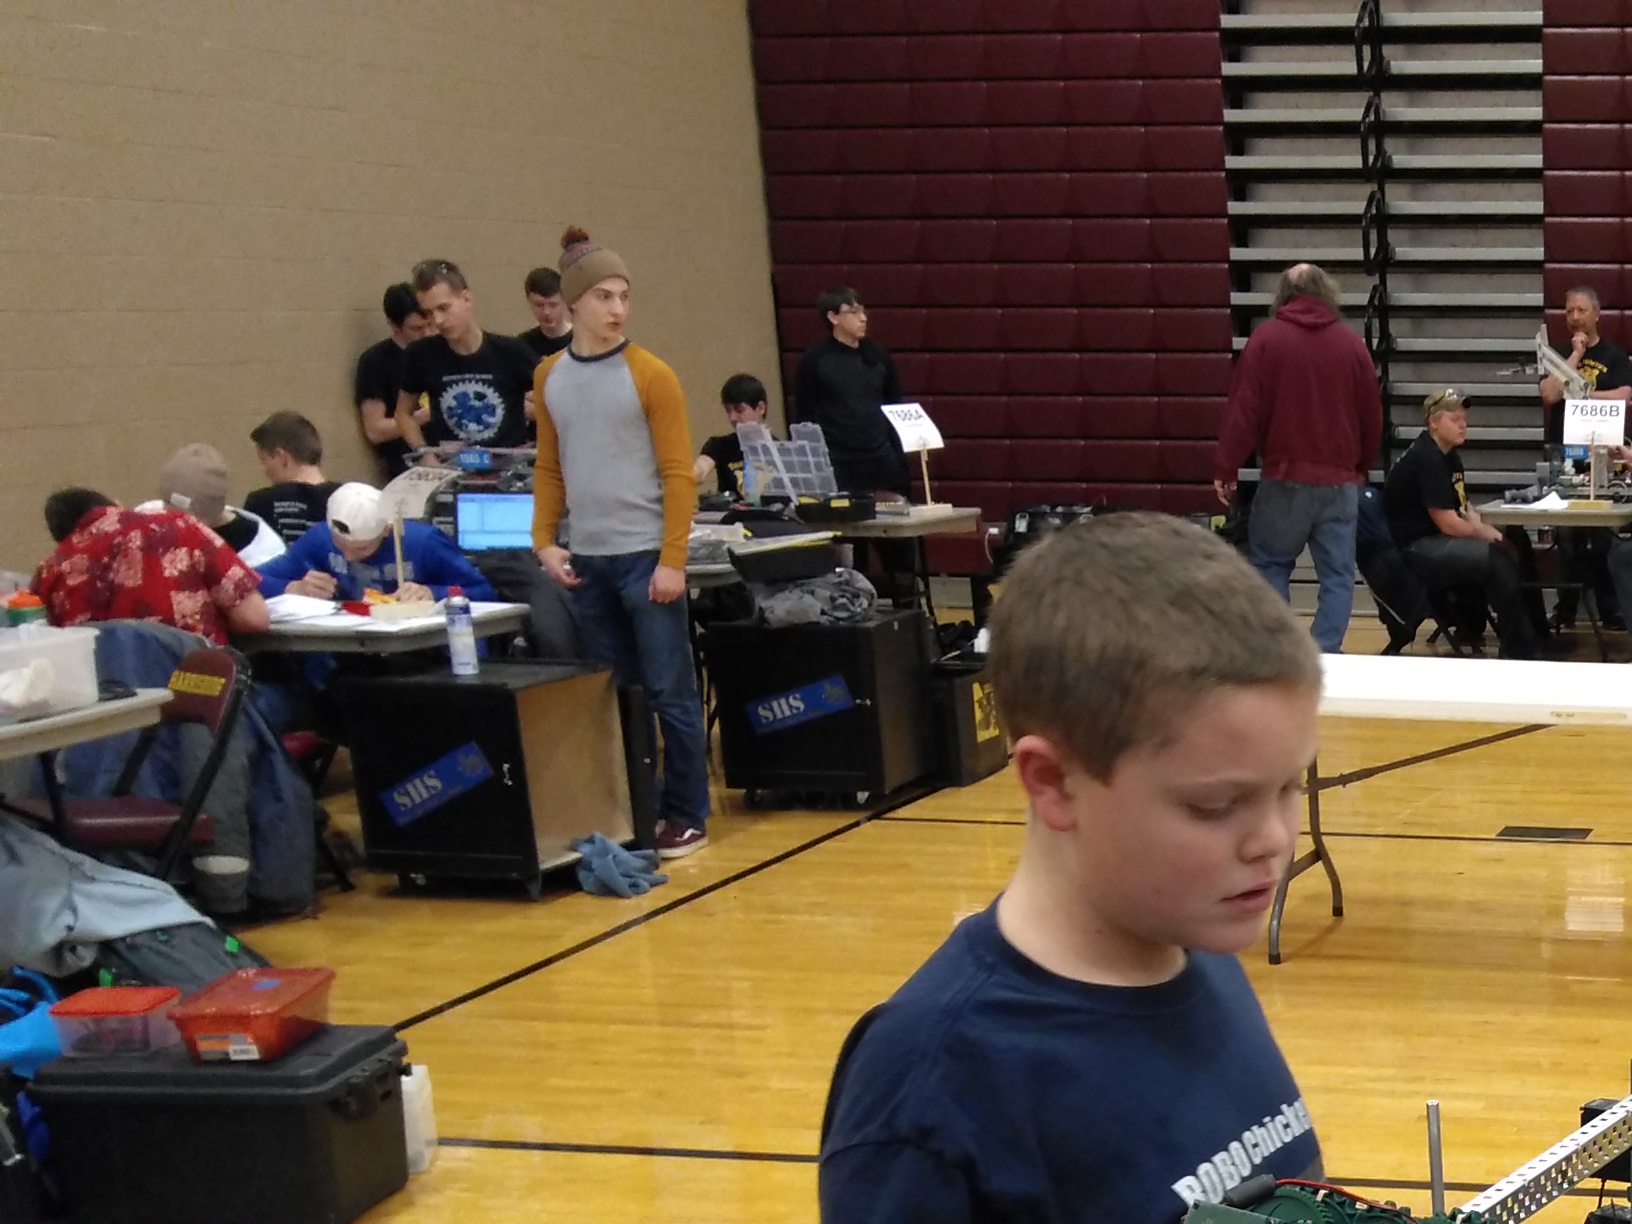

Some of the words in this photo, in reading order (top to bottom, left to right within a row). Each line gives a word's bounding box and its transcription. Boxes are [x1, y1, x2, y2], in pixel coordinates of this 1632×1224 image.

[1571, 404, 1620, 417] 7686B
[757, 693, 805, 724] SHS
[393, 770, 443, 811] SHS
